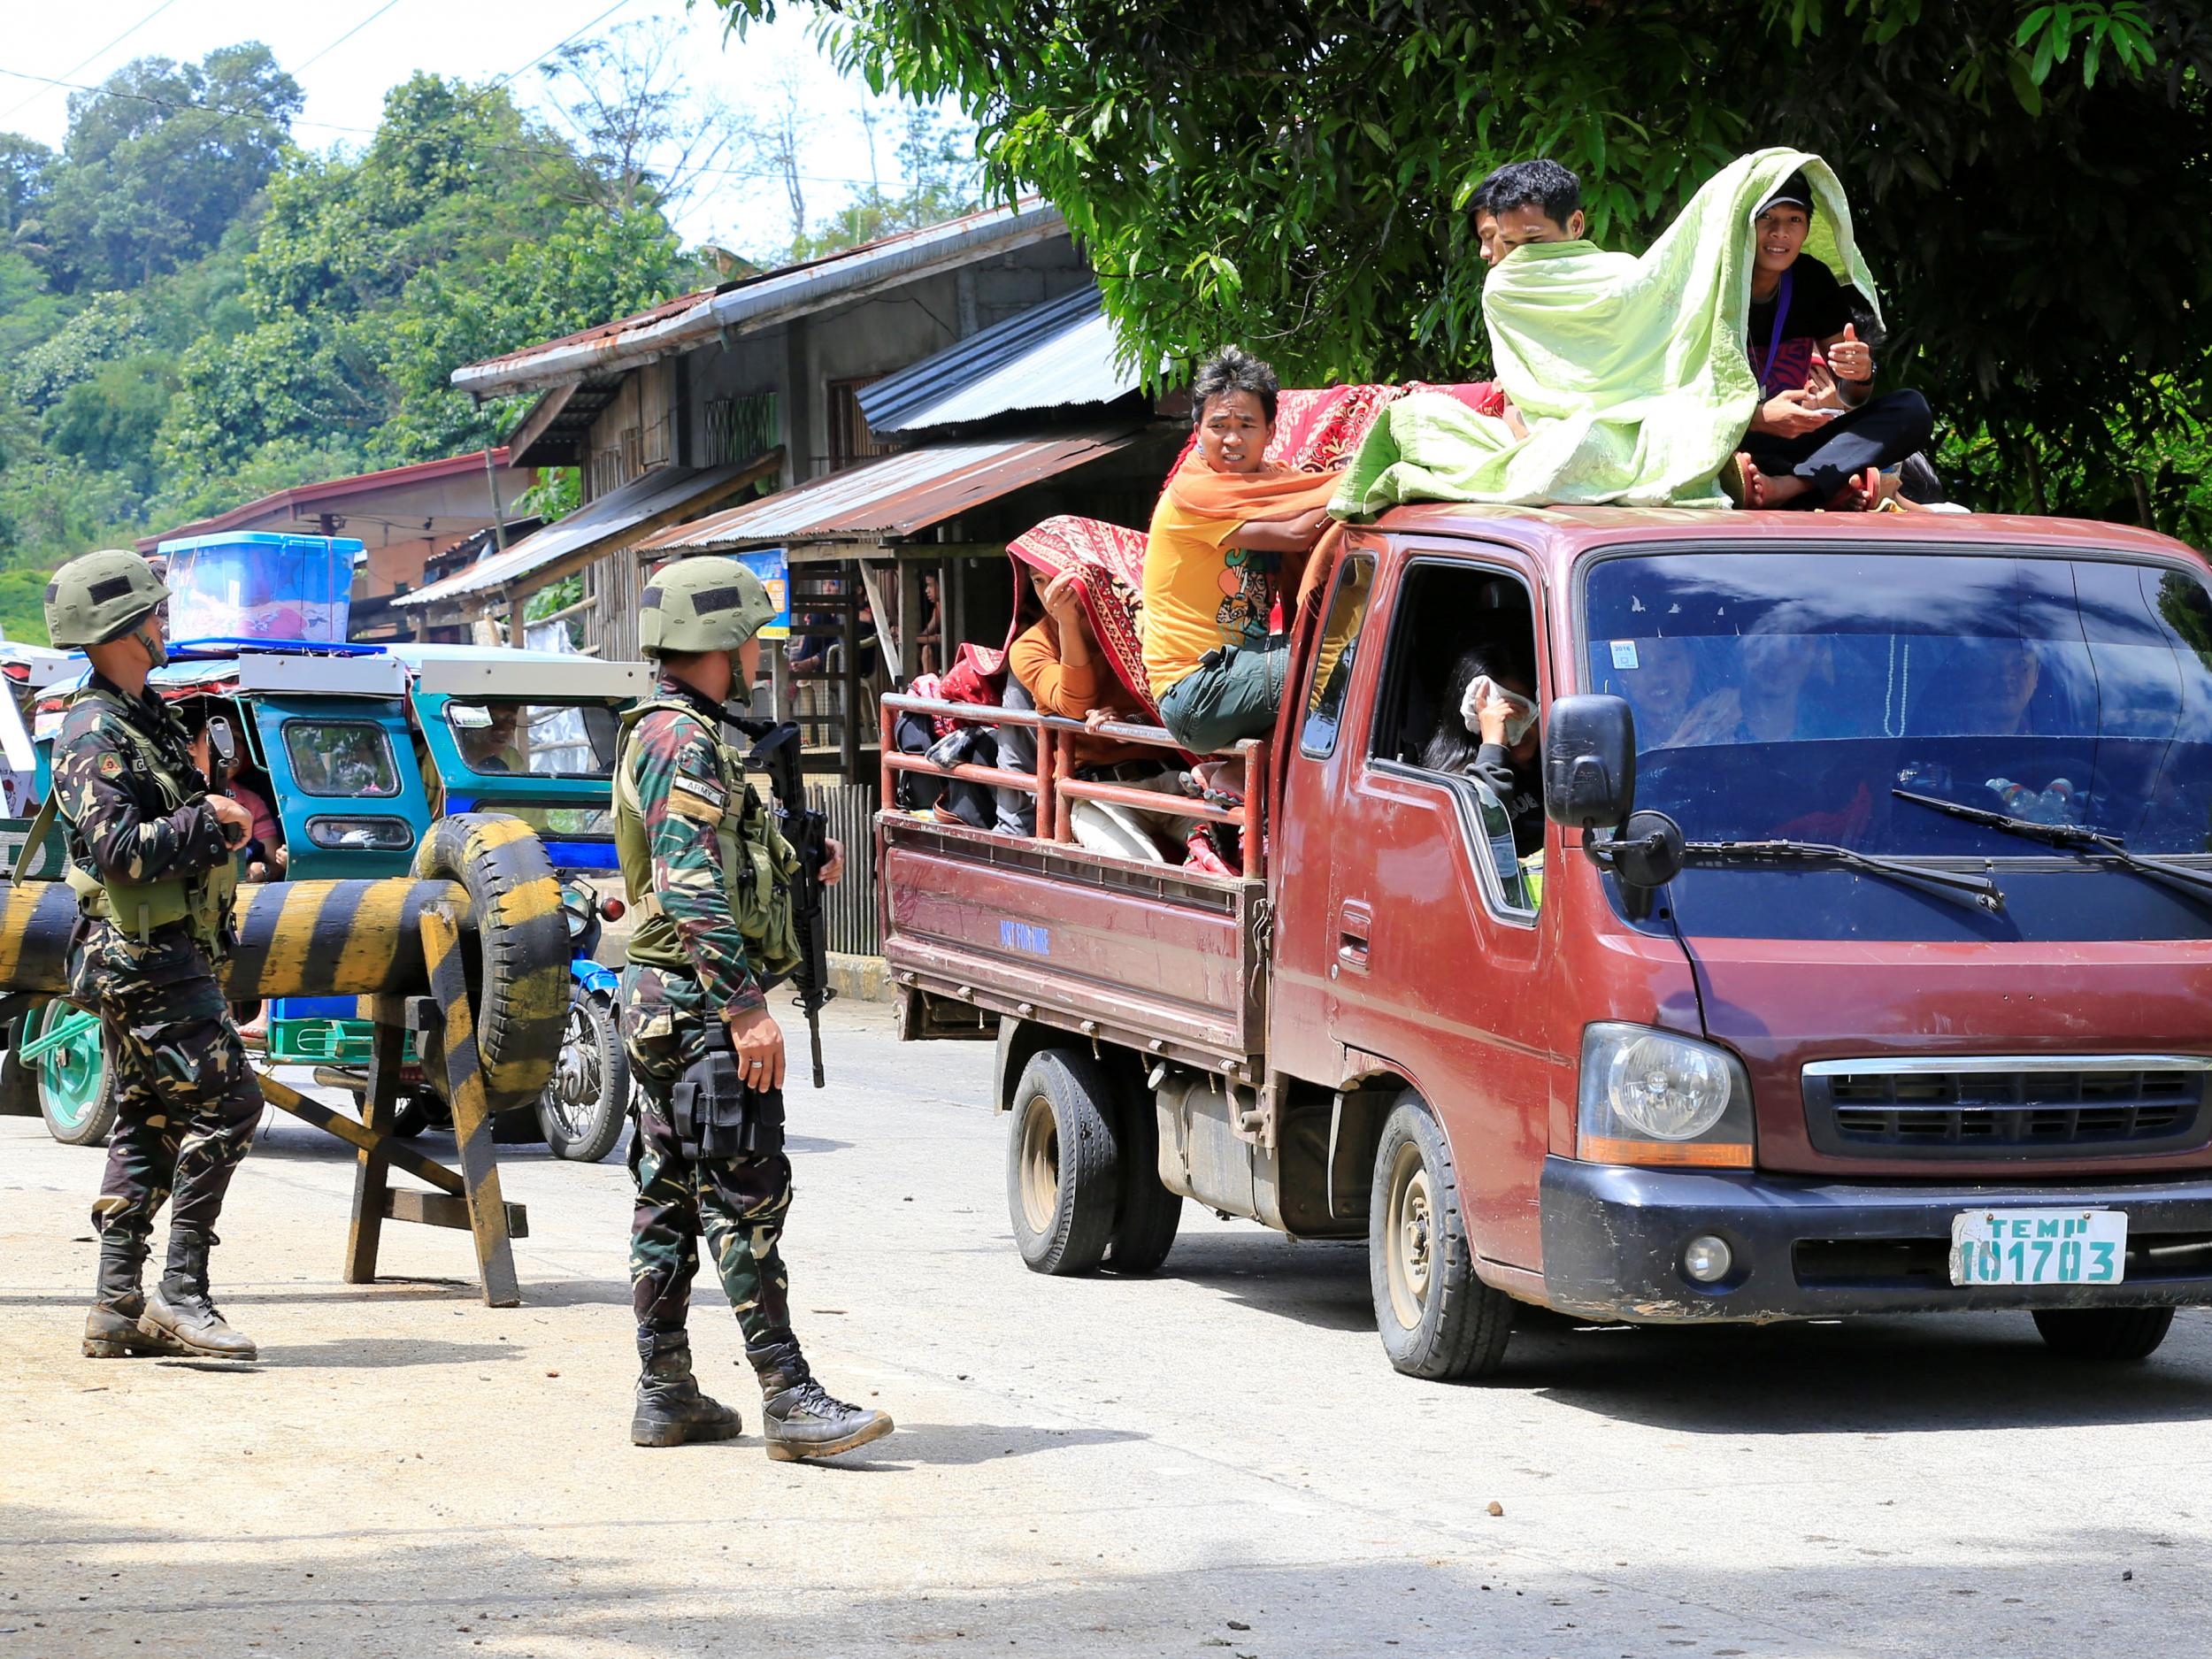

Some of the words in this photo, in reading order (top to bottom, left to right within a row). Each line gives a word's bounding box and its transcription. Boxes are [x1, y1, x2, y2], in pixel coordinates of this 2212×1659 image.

[687, 781, 713, 798] ARMY
[1987, 1218, 2088, 1239] TEMP
[1961, 1240, 2116, 1282] 101703
